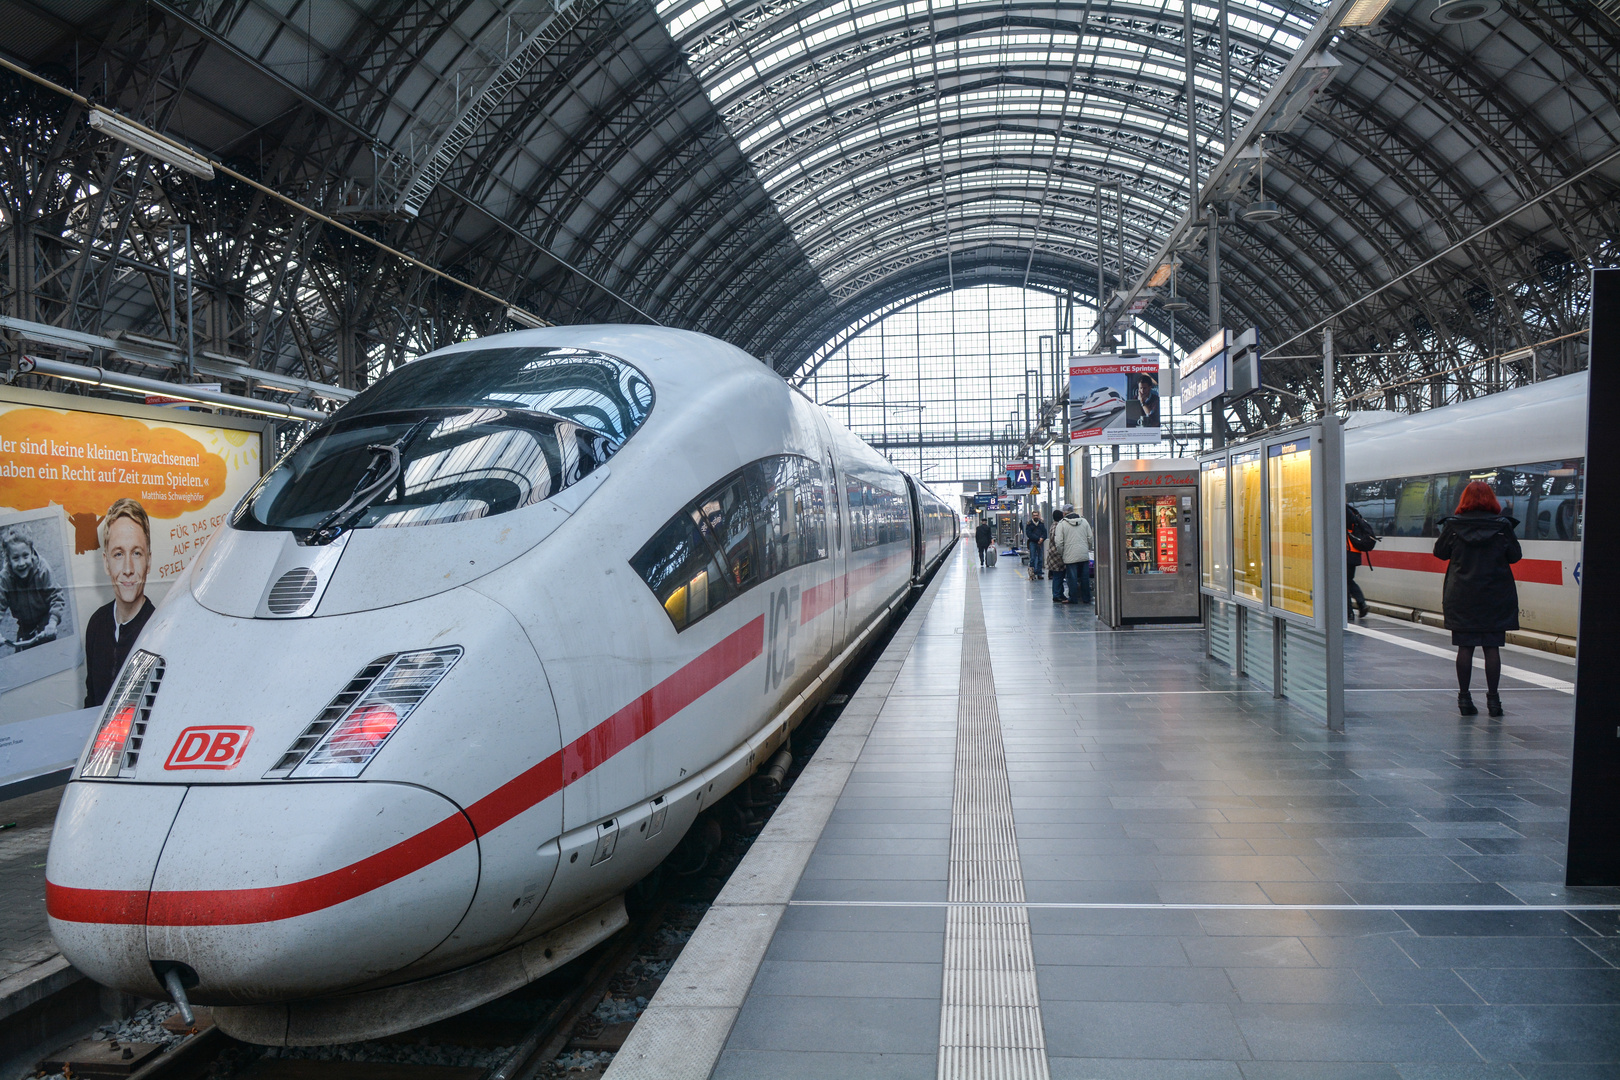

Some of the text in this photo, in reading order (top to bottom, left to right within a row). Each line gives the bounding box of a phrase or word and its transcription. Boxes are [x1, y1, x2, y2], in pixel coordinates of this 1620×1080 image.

[1093, 366, 1118, 374] Schneller.
[1131, 365, 1158, 373] Sprinter.
[0, 435, 200, 467] er sind keine kleinen Erwachsenen!
[0, 460, 35, 479] aben
[38, 463, 59, 480] ein
[61, 464, 96, 482] Recht
[98, 467, 116, 483] auf
[118, 468, 140, 485] Zeit
[141, 474, 165, 486] zum
[1016, 470, 1028, 482] A
[1122, 474, 1195, 486] Snacks & Drinks
[141, 490, 205, 503] Matthias Schweighöfer
[170, 524, 190, 540] FÜR
[192, 519, 207, 533] DAS
[173, 541, 190, 556] AUF
[159, 560, 186, 579] SPIEL
[764, 584, 800, 695] ICE
[173, 731, 242, 764] DB
